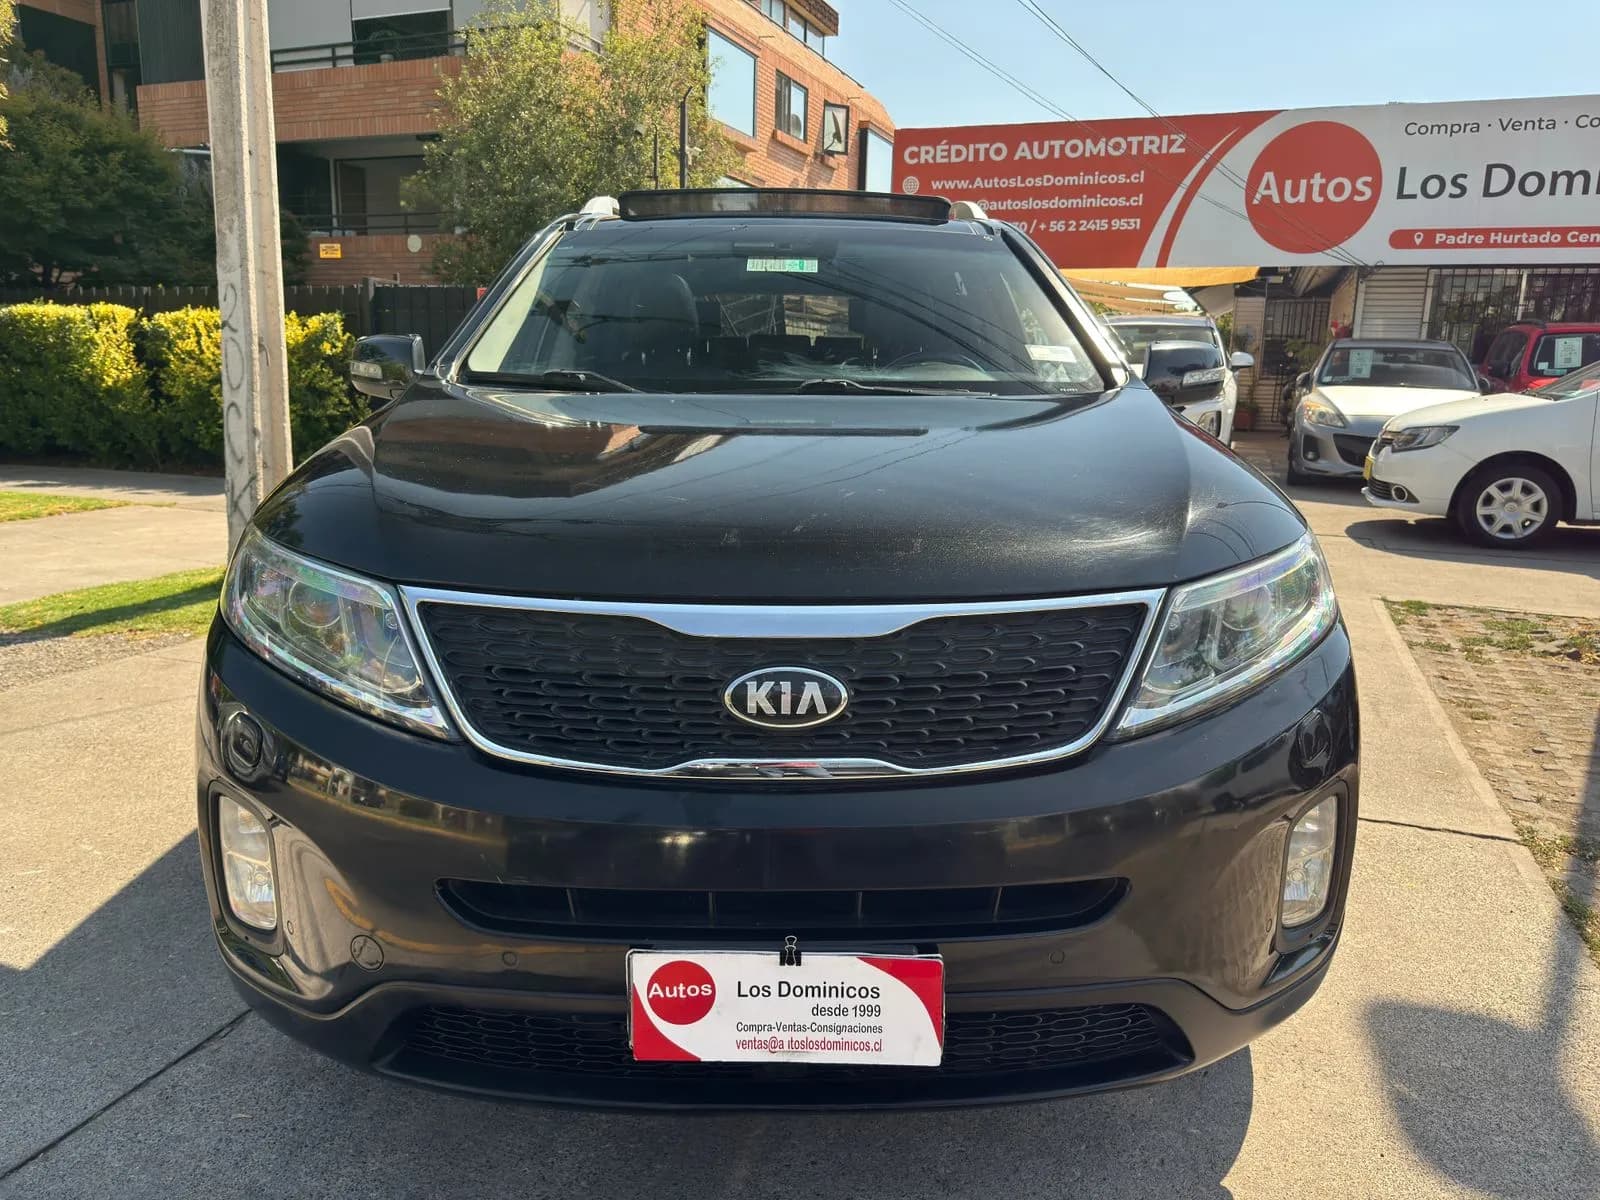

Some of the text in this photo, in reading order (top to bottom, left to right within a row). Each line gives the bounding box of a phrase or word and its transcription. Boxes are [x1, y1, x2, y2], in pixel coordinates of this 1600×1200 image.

[1404, 121, 1481, 137] Compra
[1498, 116, 1557, 132] Venta
[903, 133, 1186, 165] CRÉDITO AUTOMOTRIZ
[931, 170, 1145, 190] www.AutosLosDominicos.cl
[1252, 170, 1374, 205] Autos
[1396, 166, 1469, 201] Los
[977, 194, 1144, 211] @autoslosdominicos.cl
[1049, 220, 1066, 232] 56
[1068, 220, 1077, 231] 2
[1079, 218, 1109, 231] 2415
[1111, 218, 1141, 230] 9531
[1435, 233, 1485, 245] Padre
[1489, 231, 1561, 244] Hurtado
[745, 681, 828, 715] KIA
[648, 980, 713, 999] Autos
[737, 980, 881, 999] Los Dominicos
[811, 1004, 881, 1018] desde 1999
